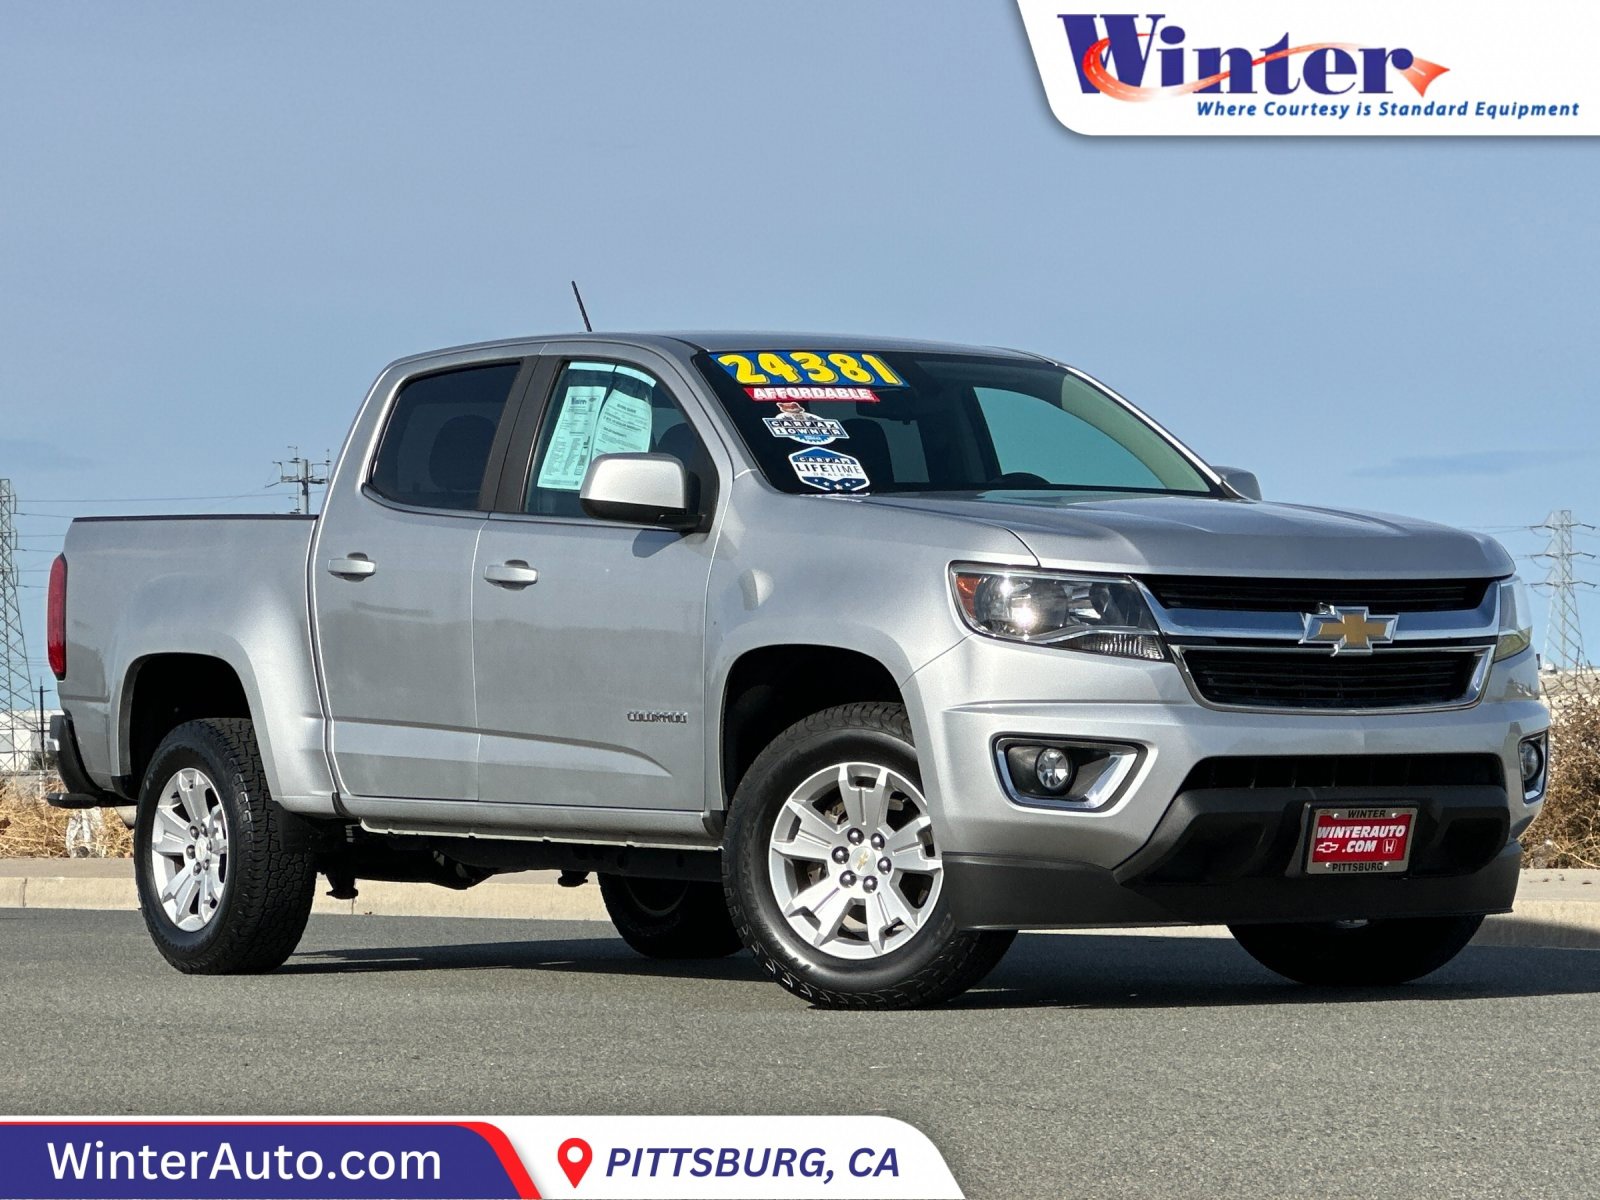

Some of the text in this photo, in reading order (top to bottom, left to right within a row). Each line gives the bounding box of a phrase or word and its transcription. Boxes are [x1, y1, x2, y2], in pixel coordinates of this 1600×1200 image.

[717, 352, 903, 385] 24381
[753, 387, 874, 400] AFFORDABLE
[770, 420, 839, 429] CARFAX
[786, 428, 842, 436] OWNER
[795, 463, 863, 474] LIFETIME
[1347, 809, 1386, 818] WINTER
[1316, 825, 1406, 838] WINTERAUTO
[1342, 840, 1377, 853] .COM
[1332, 862, 1383, 872] PITTSBURG
